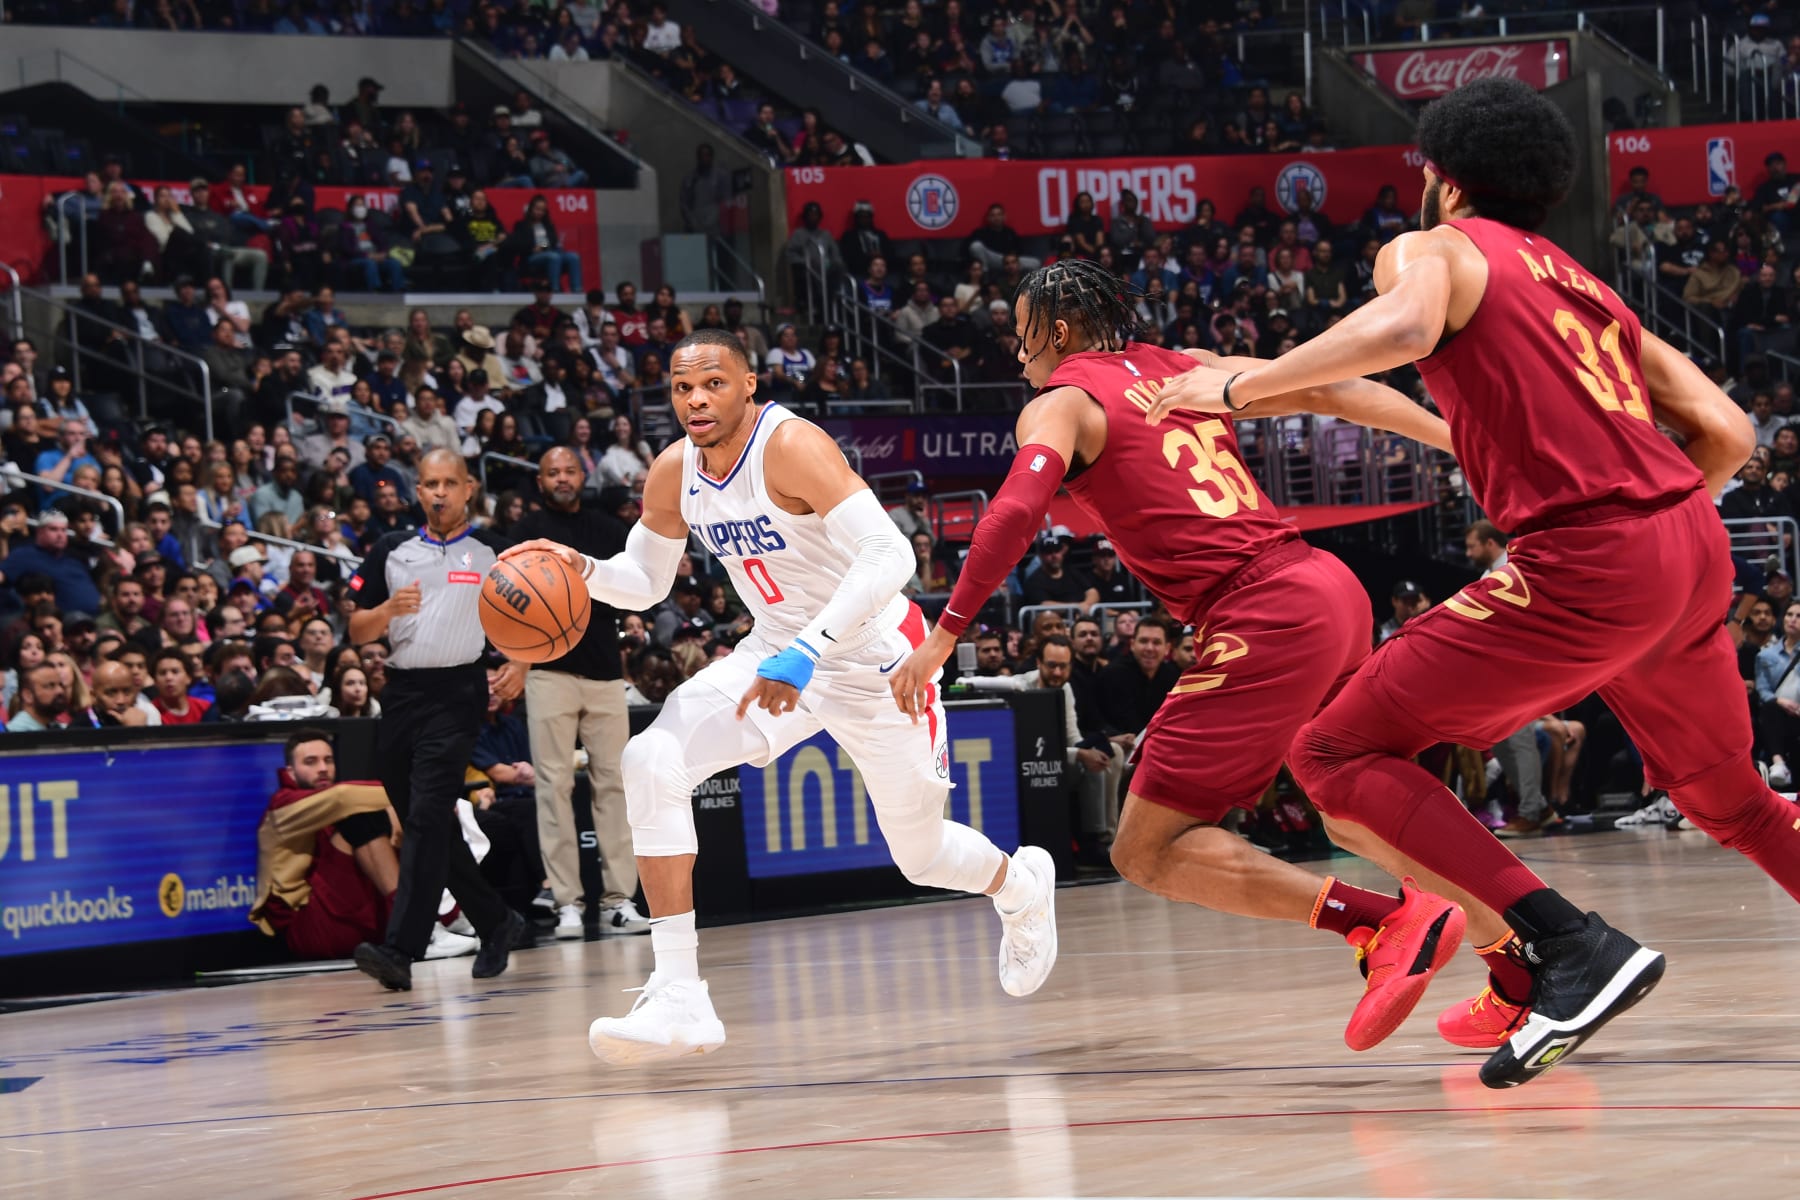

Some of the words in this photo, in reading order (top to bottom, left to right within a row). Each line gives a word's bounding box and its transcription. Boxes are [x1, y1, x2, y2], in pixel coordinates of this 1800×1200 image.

[1615, 136, 1651, 153] 106
[1402, 151, 1424, 167] 10
[791, 167, 825, 184] 105
[556, 195, 588, 212] 104
[1553, 308, 1651, 425] 31
[1123, 376, 1174, 414] OKO
[922, 431, 1017, 458] ULTRA
[1162, 419, 1259, 519] 35
[743, 558, 785, 605] 0
[1021, 760, 1063, 776] STARLUX
[3, 886, 134, 939] quickbooks
